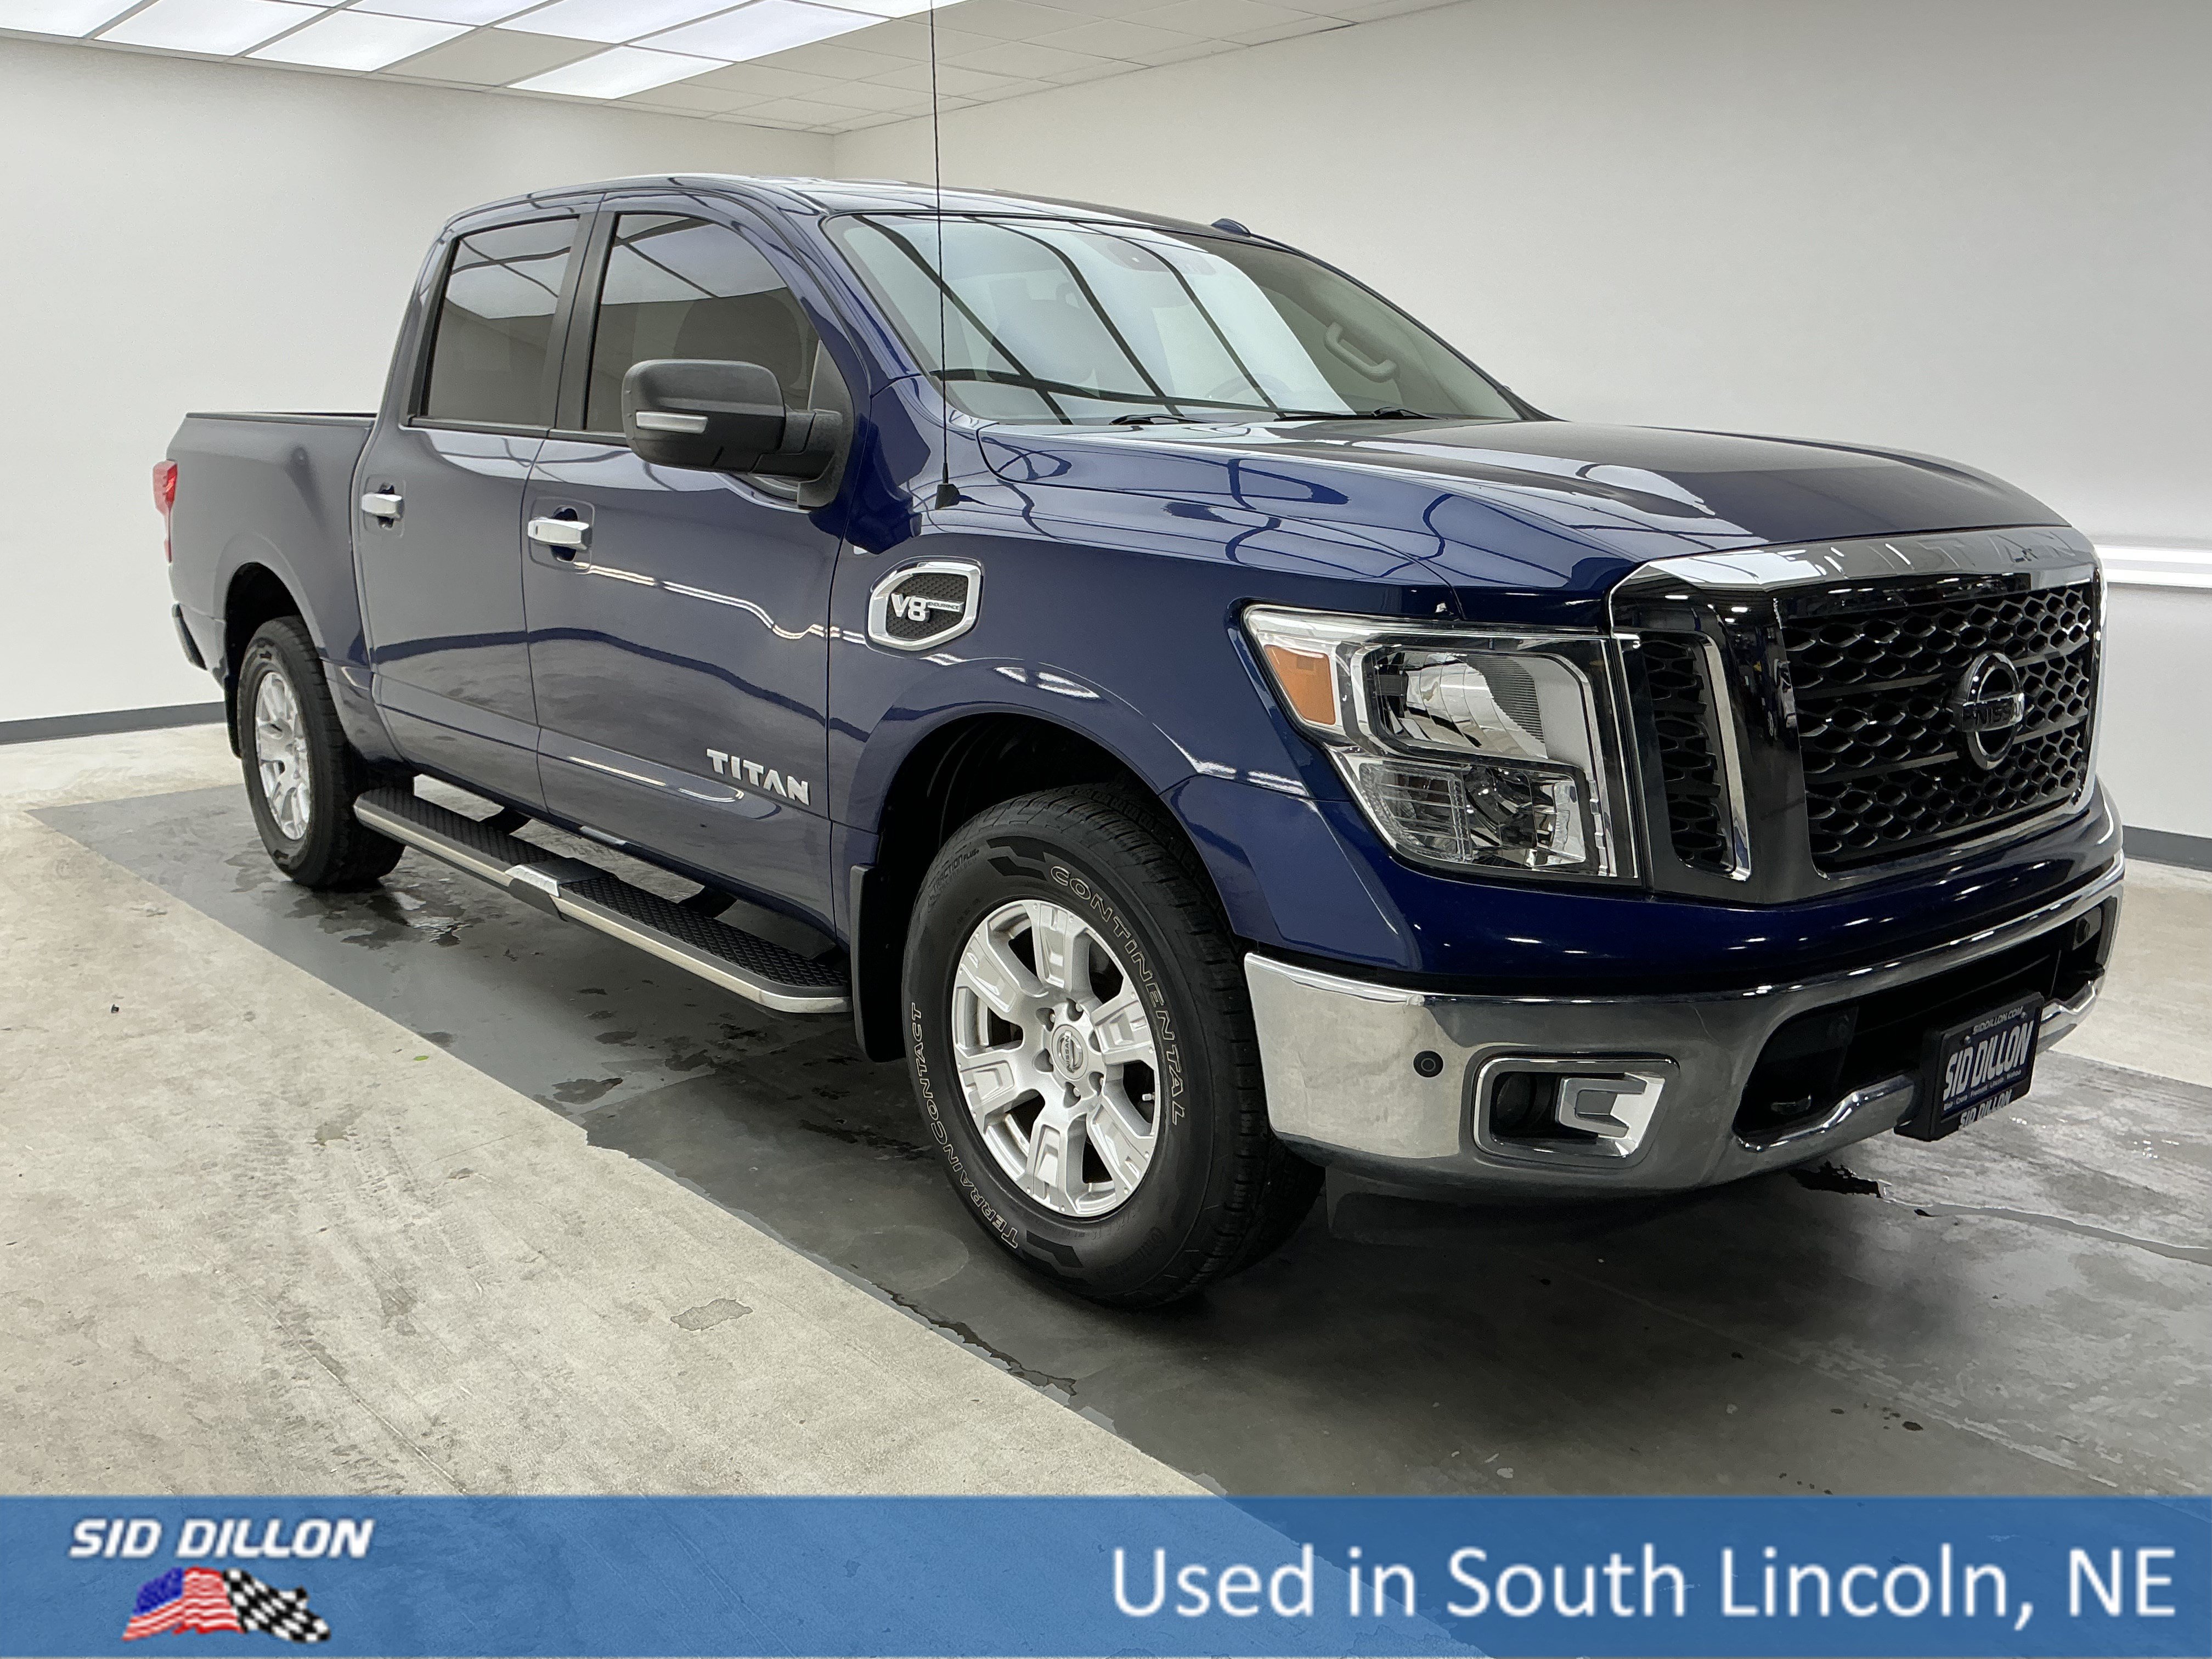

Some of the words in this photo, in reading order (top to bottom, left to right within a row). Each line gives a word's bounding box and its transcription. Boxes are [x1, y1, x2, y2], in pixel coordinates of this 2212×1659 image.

[891, 593, 927, 622] V8
[706, 748, 810, 806] TITAN
[1050, 865, 1186, 1127] CONTINENTAL
[1063, 1035, 1071, 1070] NISSAN
[1943, 1046, 1974, 1102] SID
[1971, 1020, 2034, 1088] DILLON
